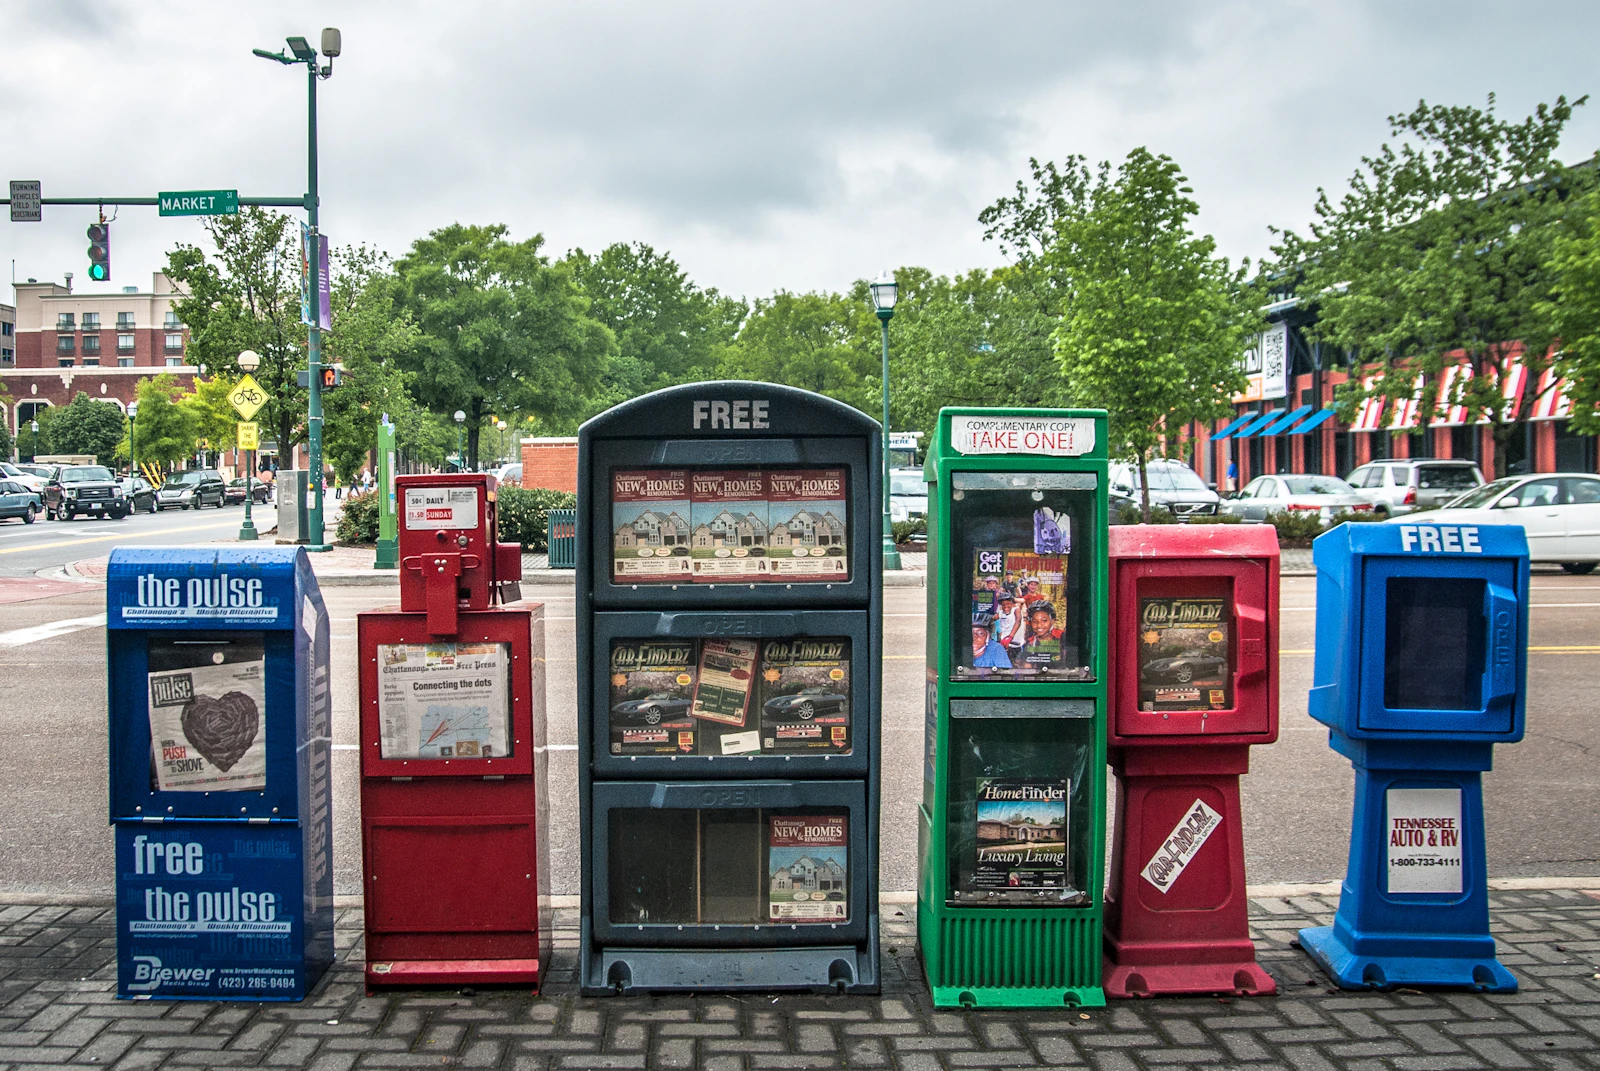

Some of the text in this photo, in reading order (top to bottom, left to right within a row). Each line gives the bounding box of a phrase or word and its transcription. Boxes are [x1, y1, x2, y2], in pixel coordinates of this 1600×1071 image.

[161, 196, 215, 211] MARKET
[692, 400, 770, 430] FREE
[967, 420, 1076, 432] COMPLIMENTARY COPY
[972, 431, 1073, 449] TAKE ONE!
[616, 479, 685, 495] NEW & HOMES
[693, 480, 762, 496] NEW & HOMES
[771, 479, 840, 495] NEW & HOMES
[1400, 525, 1483, 553] FREE
[980, 552, 1002, 563] Get
[1006, 557, 1064, 571] ADVENTURE
[980, 562, 1002, 573] Out
[138, 573, 263, 609] the pulse
[703, 618, 763, 635] OPEN
[383, 666, 429, 674] Chattanooga
[456, 661, 472, 669] Free
[474, 660, 496, 670] Press
[153, 676, 192, 705] pulse
[413, 679, 492, 691] Connecting the dots
[163, 746, 187, 760] PUSH
[176, 758, 204, 772] SHOVE
[702, 788, 762, 806] OPEN
[984, 786, 1066, 800] HomeFinder
[310, 750, 328, 882] pulse
[1392, 817, 1456, 829] TENNESSEE
[774, 826, 799, 837] NEW
[804, 826, 843, 837] HOMES
[1202, 818, 1217, 838] group
[1390, 829, 1459, 847] AUTO & RV
[133, 835, 203, 875] free
[977, 848, 1065, 867] Luxury Living
[1390, 858, 1460, 867] 1-800-733-4111
[145, 886, 275, 922] the pulse
[134, 962, 215, 980] Brewer
[218, 977, 245, 989] (423)
